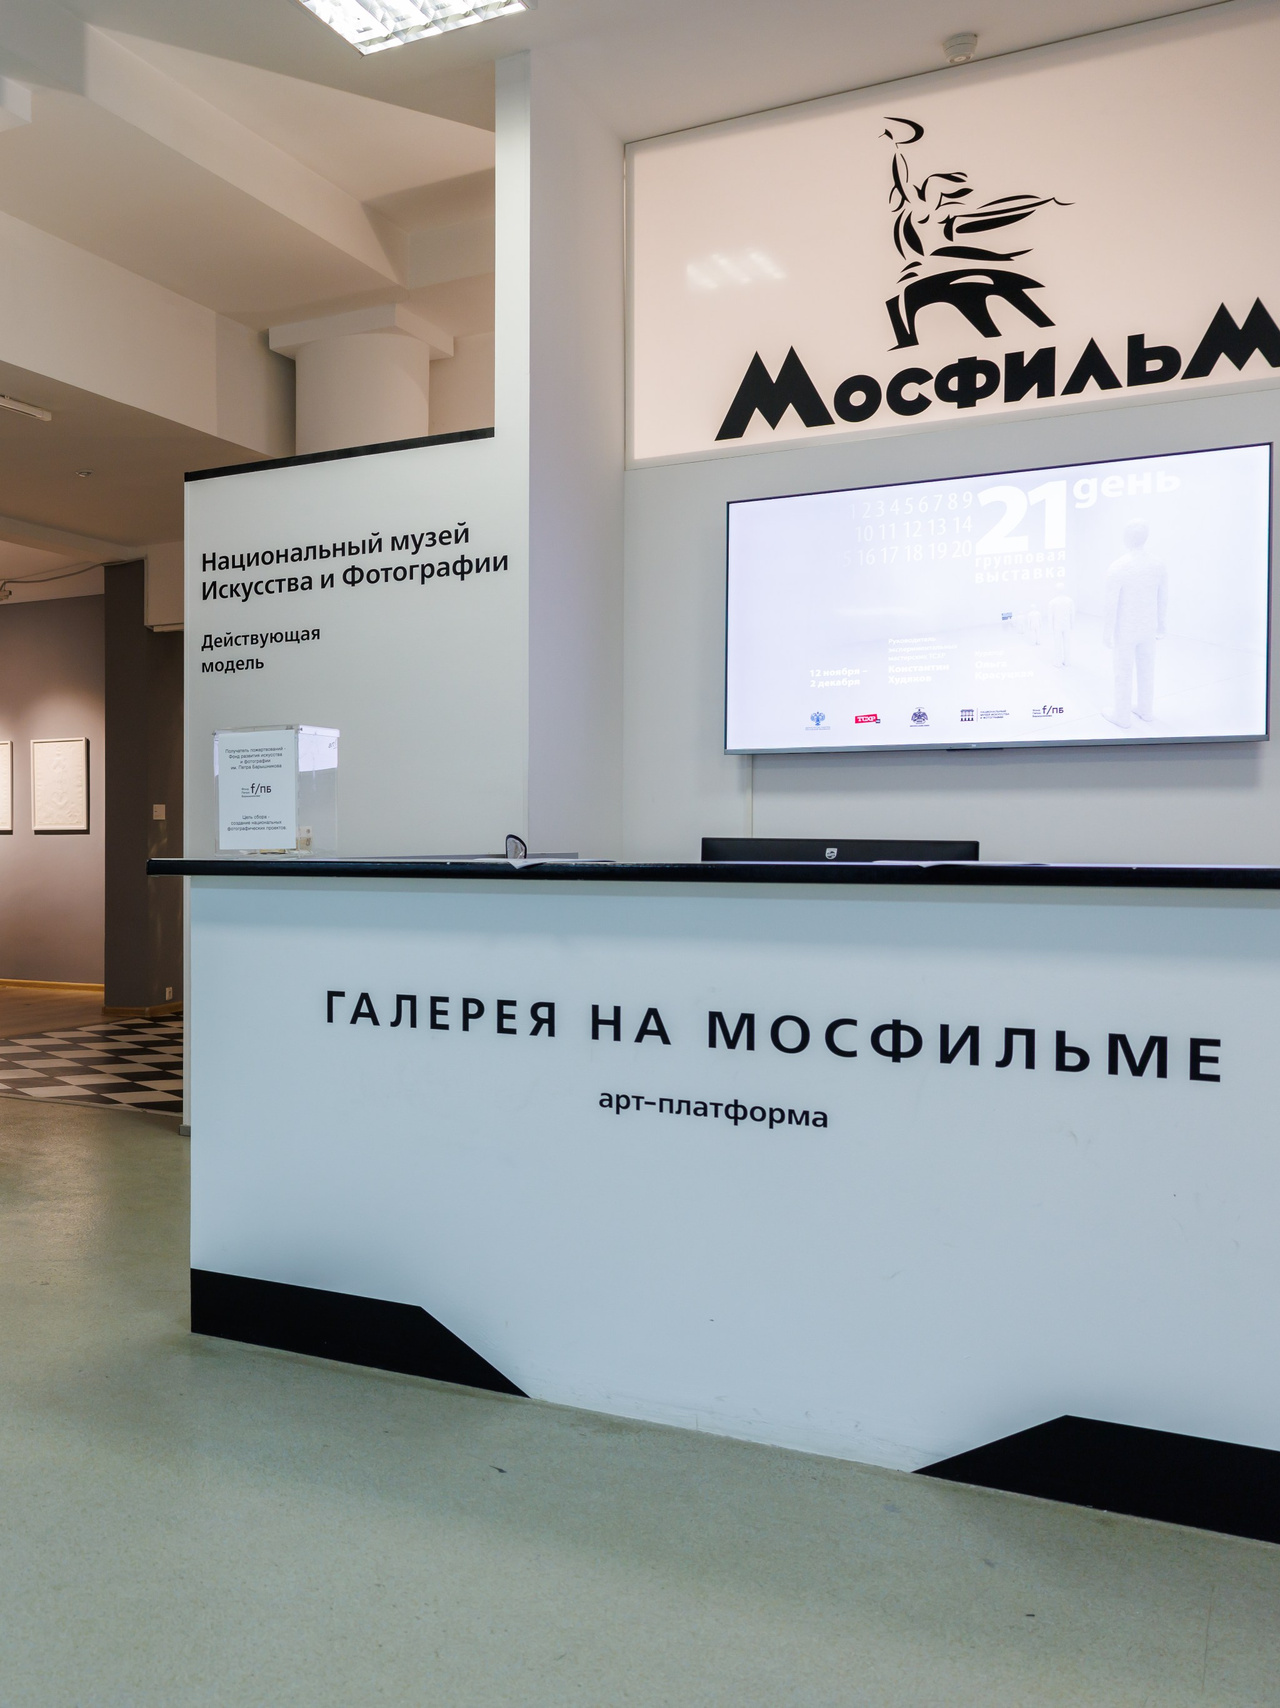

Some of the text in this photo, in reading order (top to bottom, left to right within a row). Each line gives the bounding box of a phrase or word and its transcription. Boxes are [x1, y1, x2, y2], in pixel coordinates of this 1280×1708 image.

[862, 502, 871, 519] 2
[876, 500, 885, 517] 3
[890, 499, 900, 516] 4
[904, 497, 914, 515] 5
[918, 495, 928, 513] 6
[933, 494, 943, 512] 7
[948, 492, 958, 510] 8
[962, 491, 973, 509] 9
[855, 515, 973, 543] 10 11 12 13 14
[975, 480, 1067, 556] 21
[203, 522, 469, 573] Национальный музей
[880, 546, 898, 564] 17
[905, 544, 923, 562] 18
[928, 542, 947, 561] 19
[952, 539, 972, 559] 20
[975, 550, 1067, 569] групповая
[202, 554, 508, 603] Искусства и Фотографии
[975, 566, 1066, 584] выставка
[201, 629, 321, 652] Действующая
[201, 658, 265, 675] модель
[809, 668, 821, 678] 12
[822, 667, 861, 678] ноября
[888, 662, 950, 675] Константин
[809, 678, 861, 689] 2 декабря
[326, 991, 1221, 1083] ГАЛЕРЕЯ НА МОСФИЛЬМЕ
[598, 1092, 828, 1130] арт-платформа
